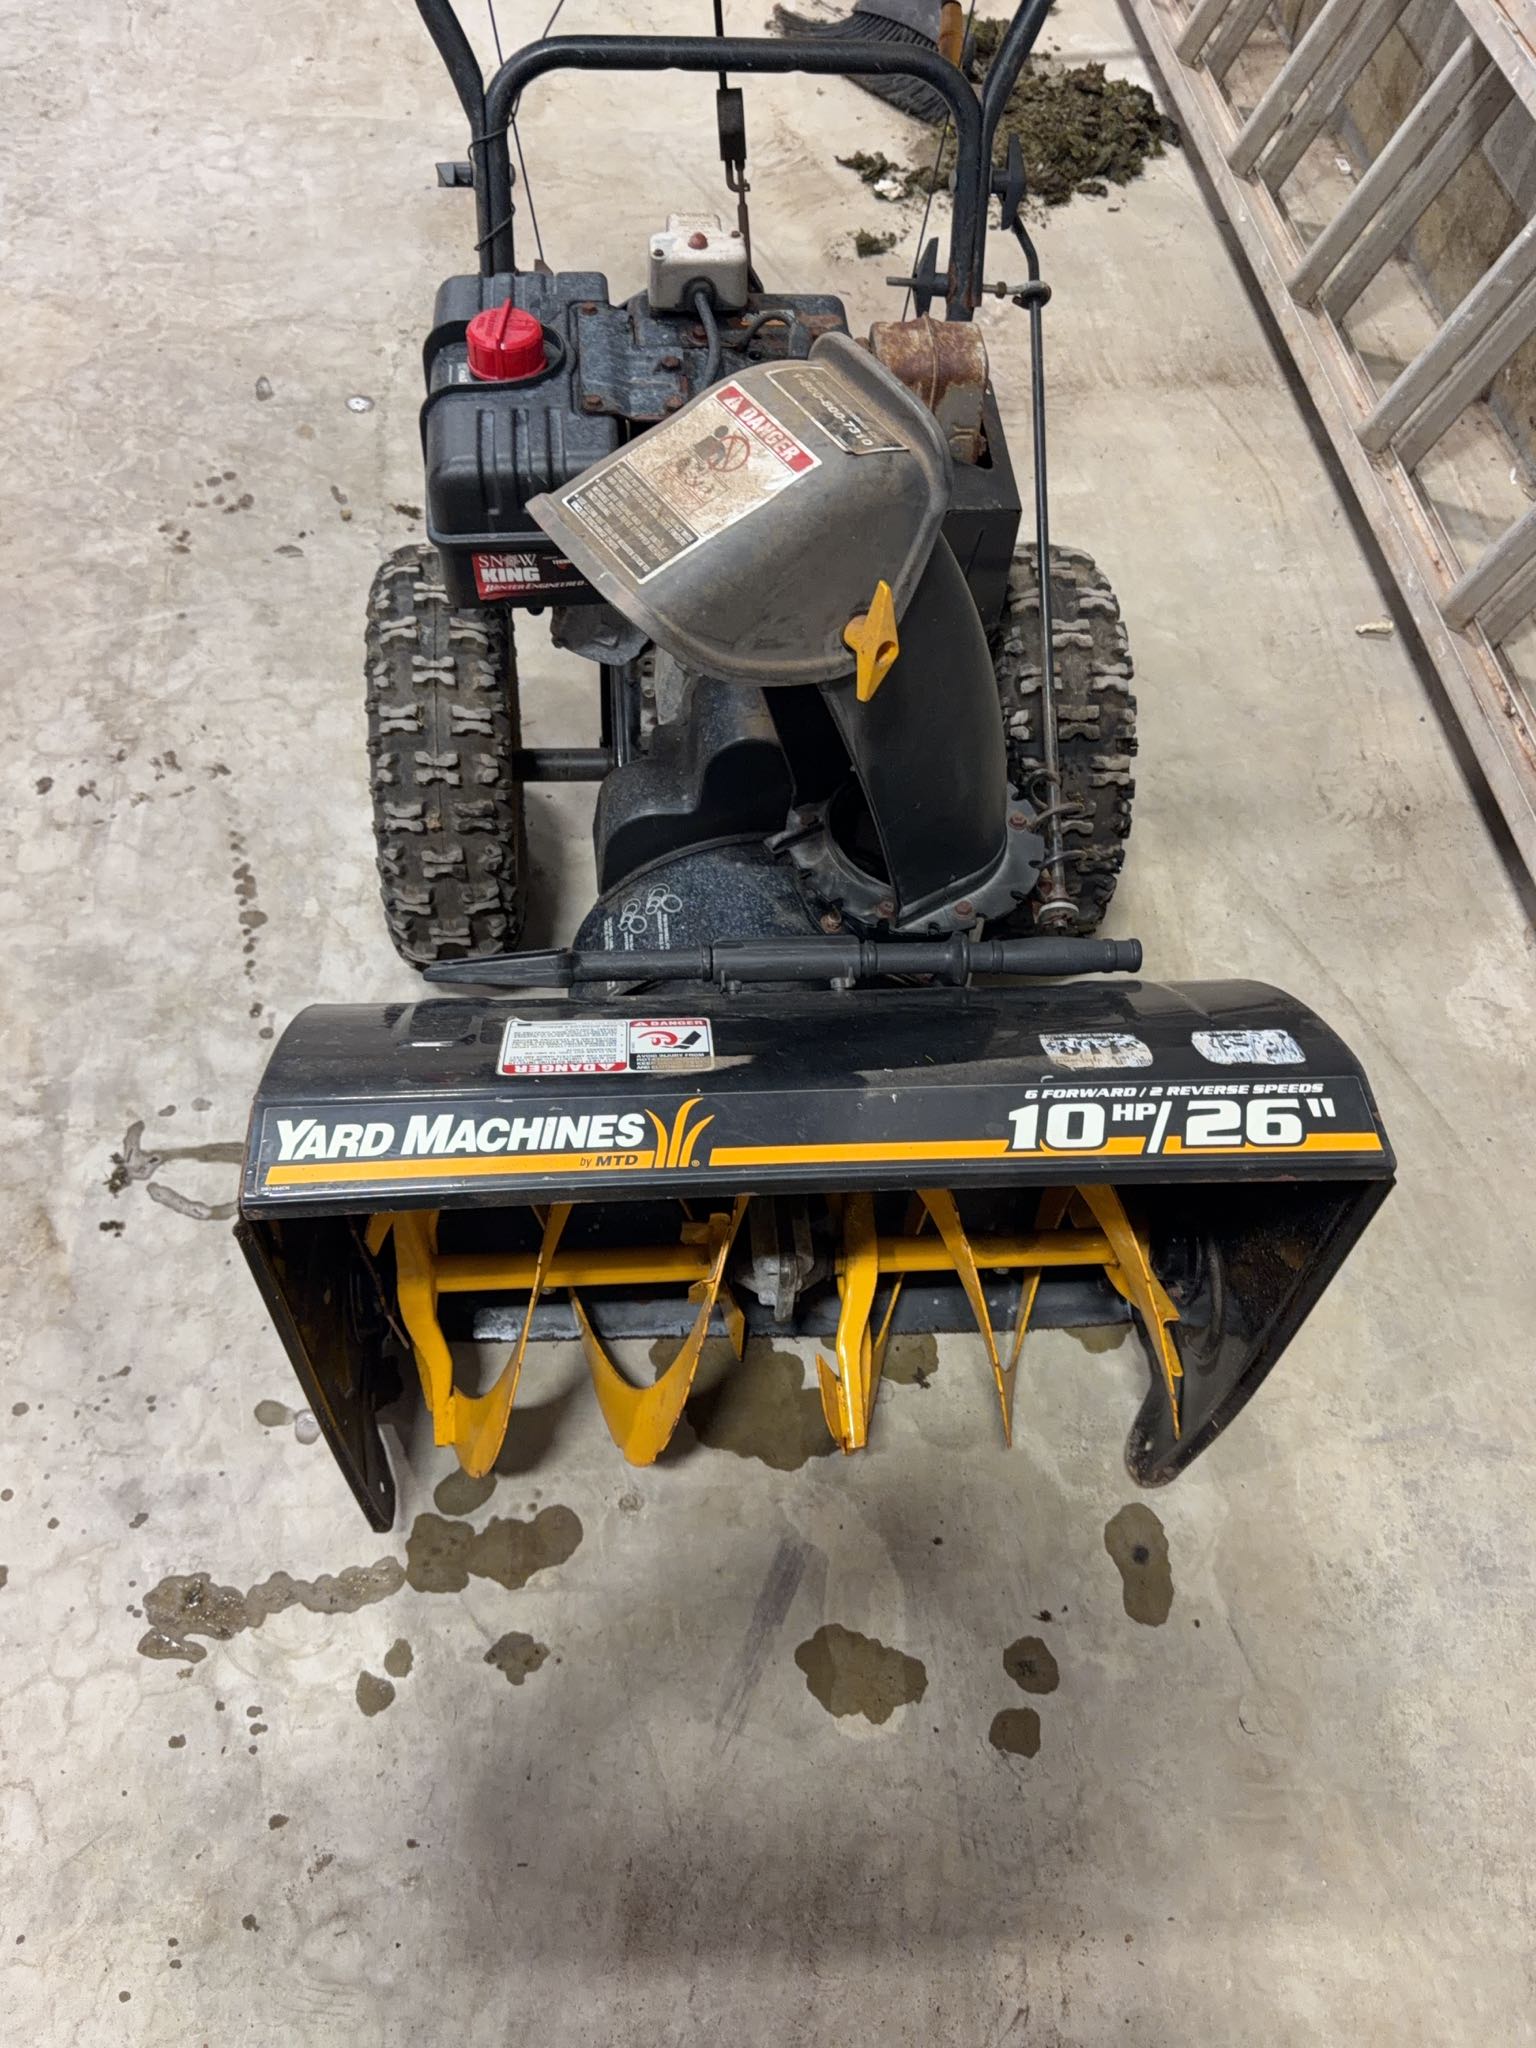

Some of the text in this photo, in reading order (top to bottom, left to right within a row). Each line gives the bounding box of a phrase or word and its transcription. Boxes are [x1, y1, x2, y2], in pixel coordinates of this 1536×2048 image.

[739, 405, 800, 462] DANGER
[480, 567, 541, 582] KING
[514, 1063, 596, 1073] DANGER
[1024, 1089, 1038, 1099] 6
[1041, 1087, 1137, 1099] FORWARD
[1149, 1086, 1164, 1096] 2
[1166, 1084, 1249, 1096] REVERSE
[1252, 1083, 1324, 1094] SPEEDS
[275, 1113, 646, 1161] YARD MACHINES
[579, 1154, 639, 1168] by MTD
